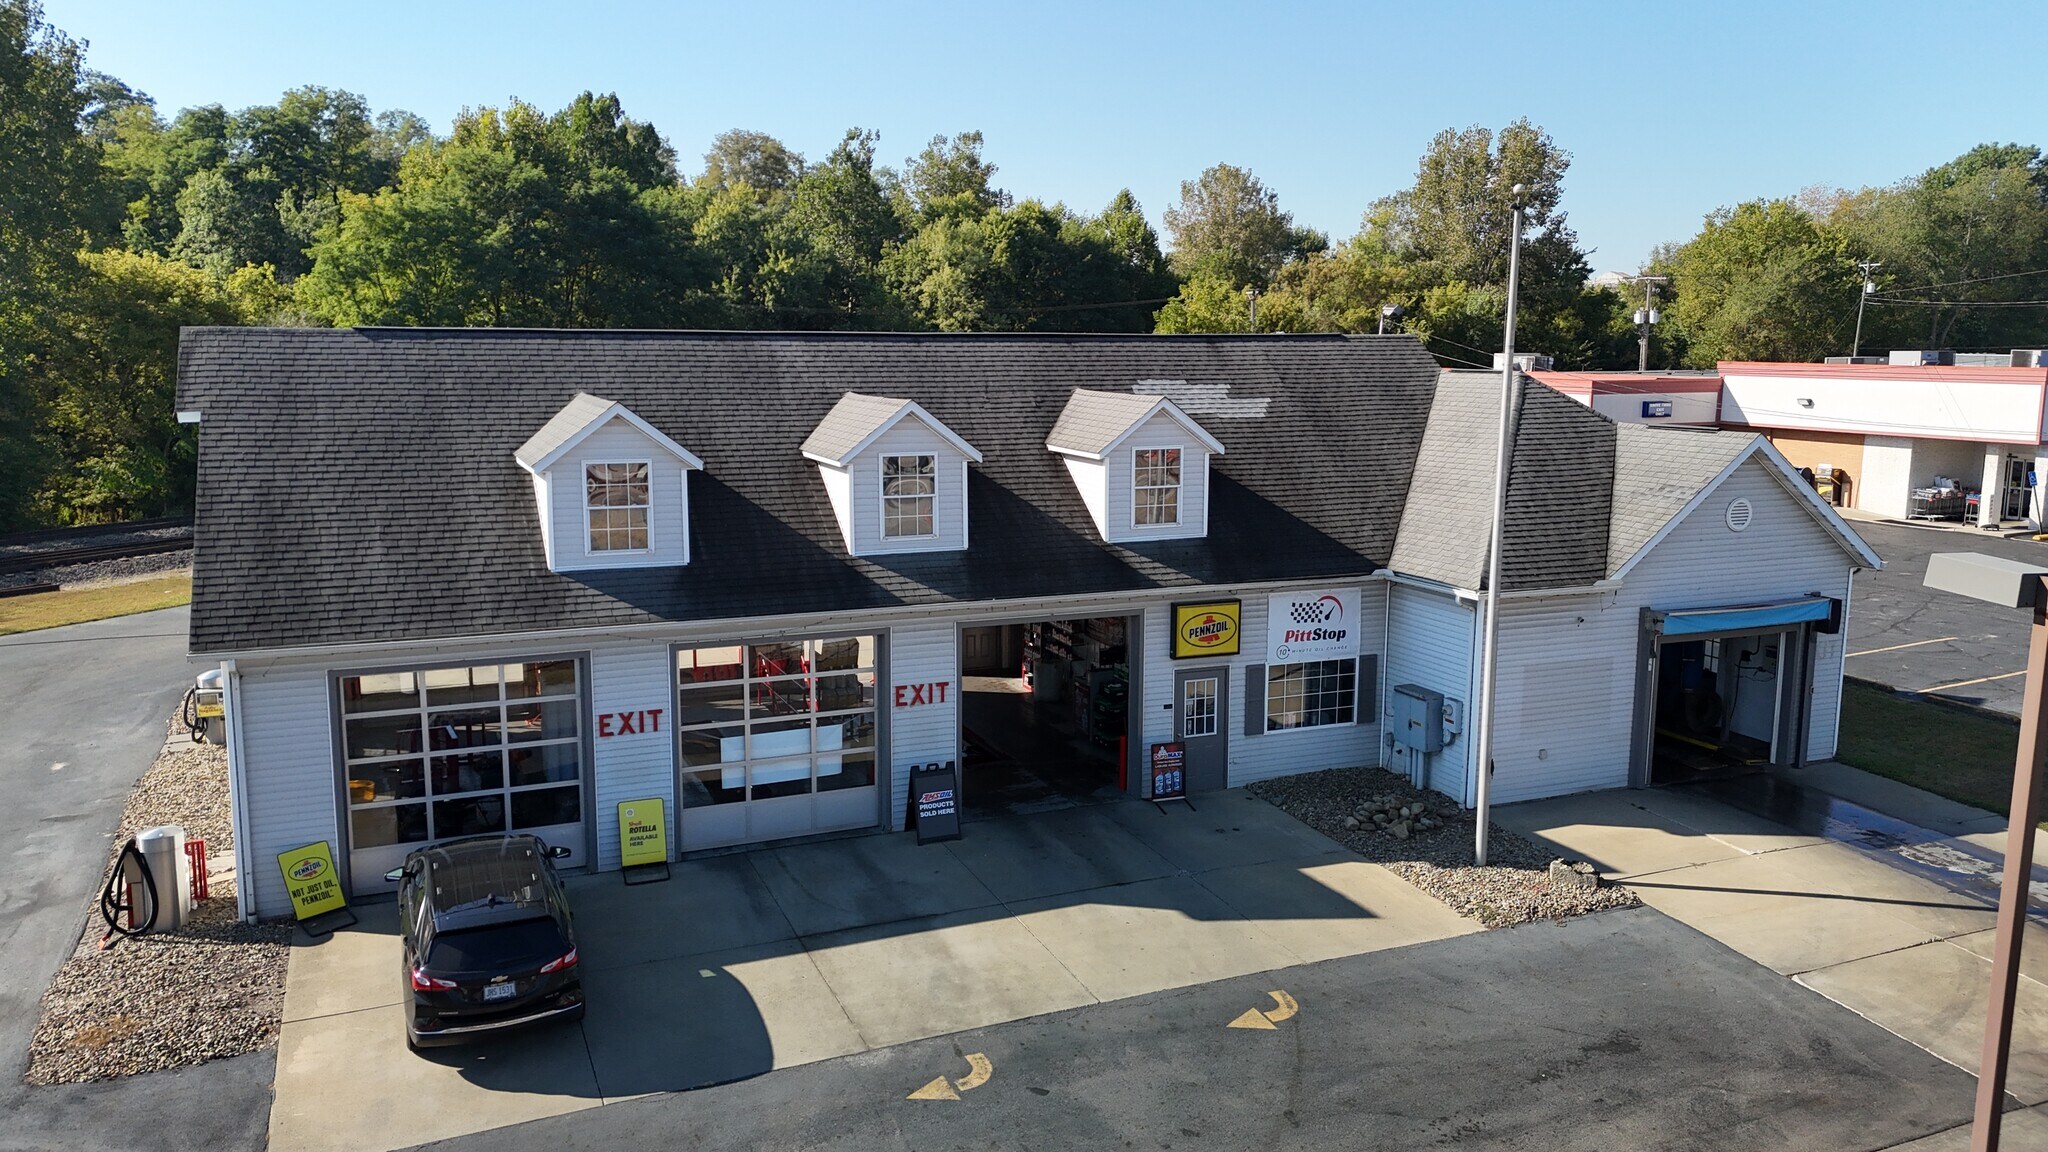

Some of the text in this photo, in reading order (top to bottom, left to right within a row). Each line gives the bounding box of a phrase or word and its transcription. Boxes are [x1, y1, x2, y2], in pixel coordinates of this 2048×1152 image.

[1284, 627, 1346, 643] PittStop
[895, 682, 949, 707] EXIT
[598, 708, 663, 737] EXIT
[919, 790, 953, 803] AMSOIL
[919, 800, 954, 810] PRODUCTS
[629, 824, 657, 834] ROTELLA
[629, 833, 658, 841] AVAILABLE
[292, 879, 338, 899] NOT JUST OIL,
